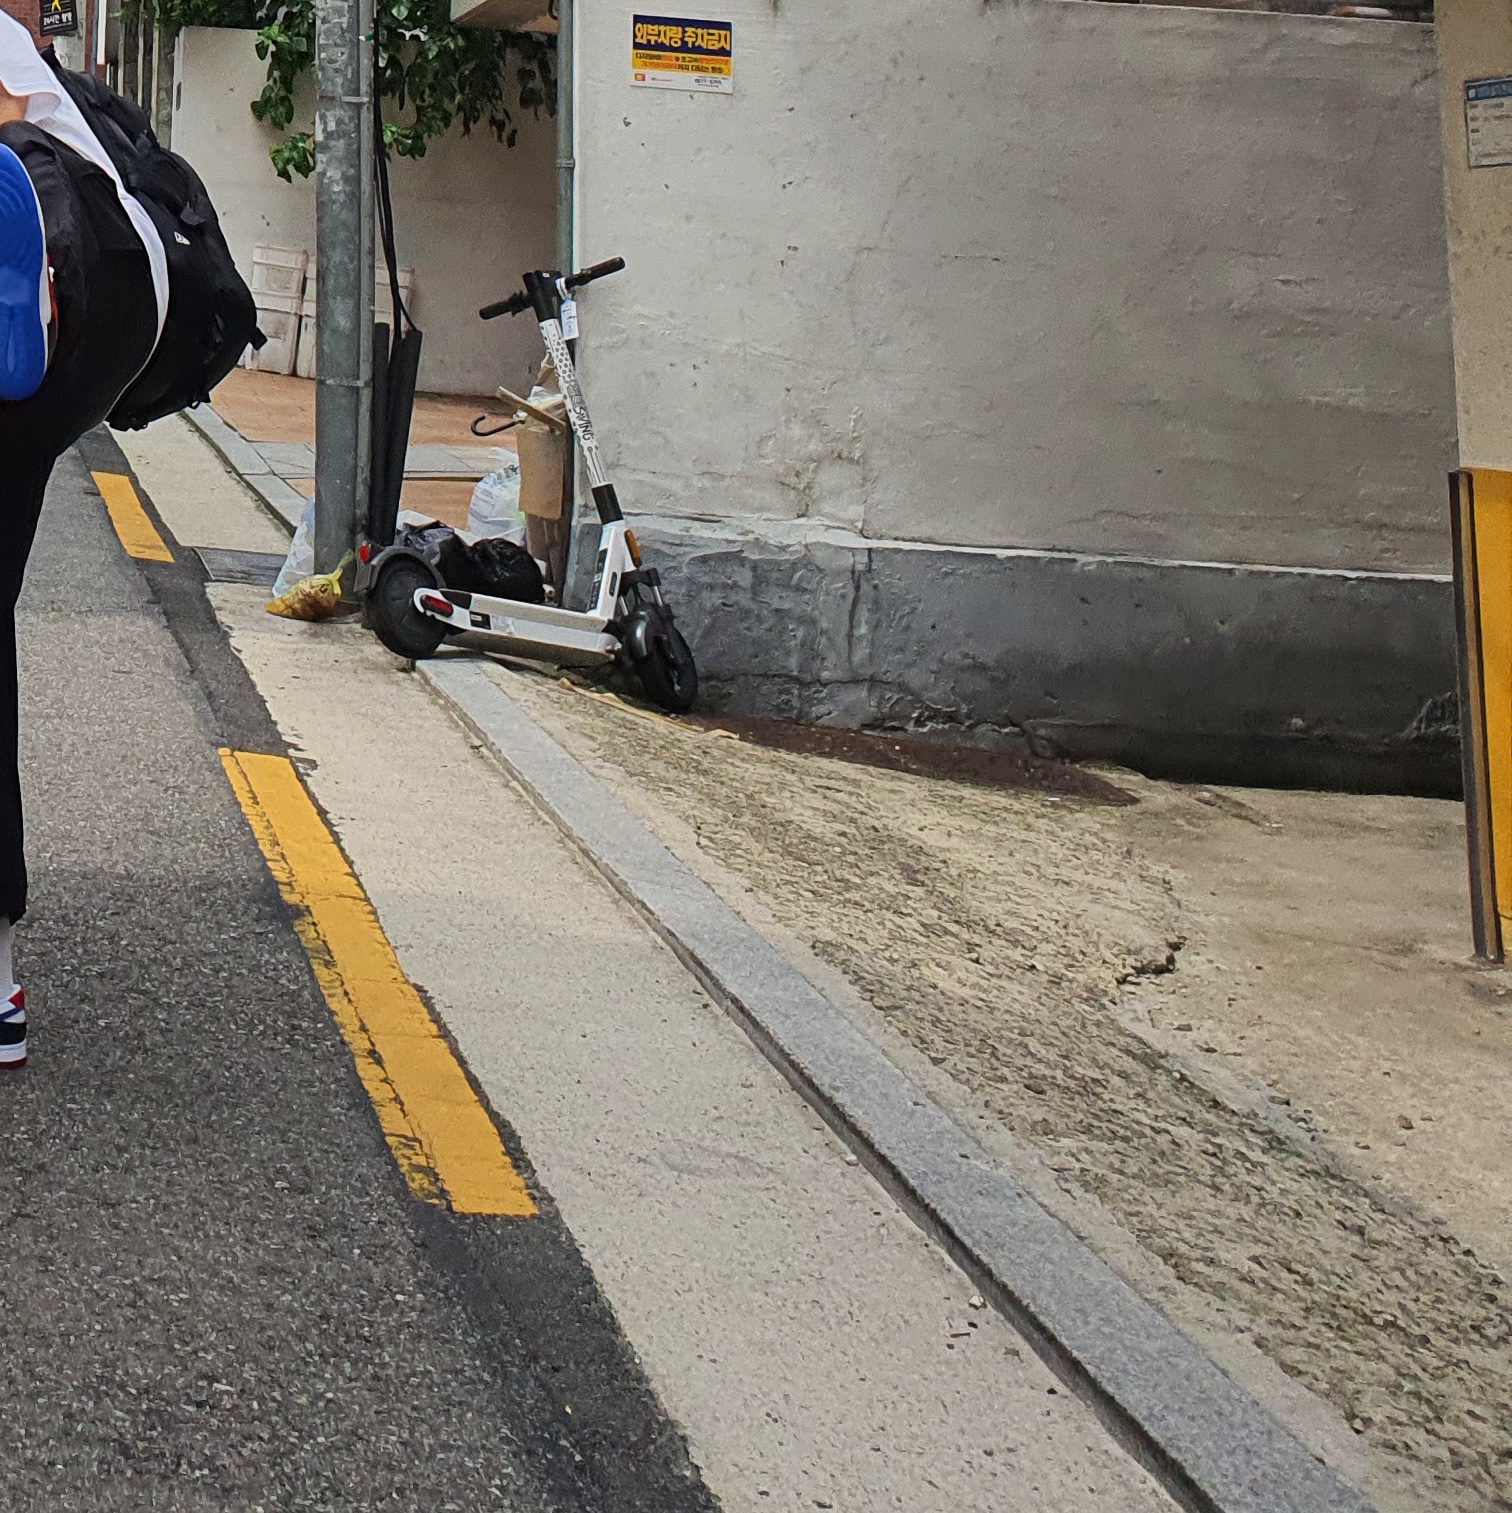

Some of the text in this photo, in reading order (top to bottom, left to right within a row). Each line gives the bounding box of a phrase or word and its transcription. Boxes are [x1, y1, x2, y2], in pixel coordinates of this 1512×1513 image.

[635, 22, 731, 52] 외부차량 주차금지
[573, 406, 595, 443] SWING
